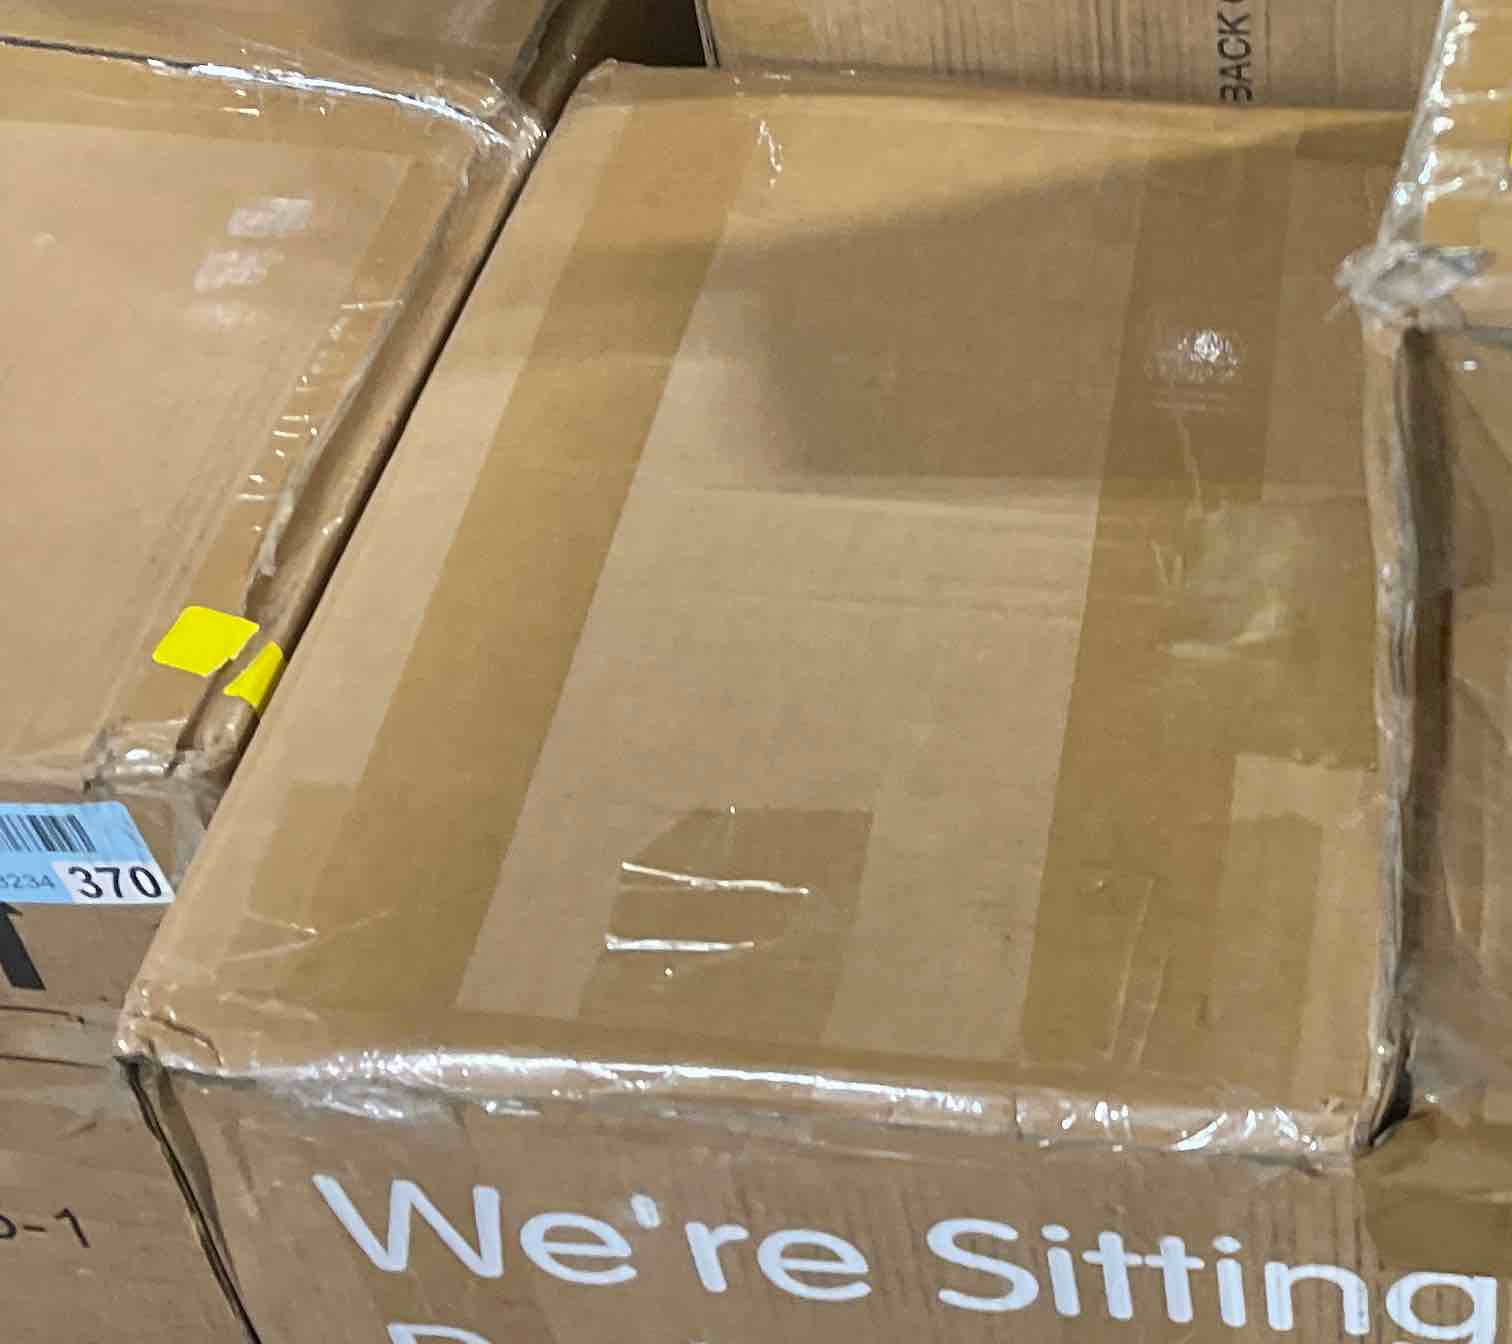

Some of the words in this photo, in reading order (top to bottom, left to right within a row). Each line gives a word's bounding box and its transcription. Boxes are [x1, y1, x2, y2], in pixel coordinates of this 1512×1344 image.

[1218, 9, 1252, 105] BACK
[68, 865, 162, 898] 370
[313, 1173, 872, 1302] We're
